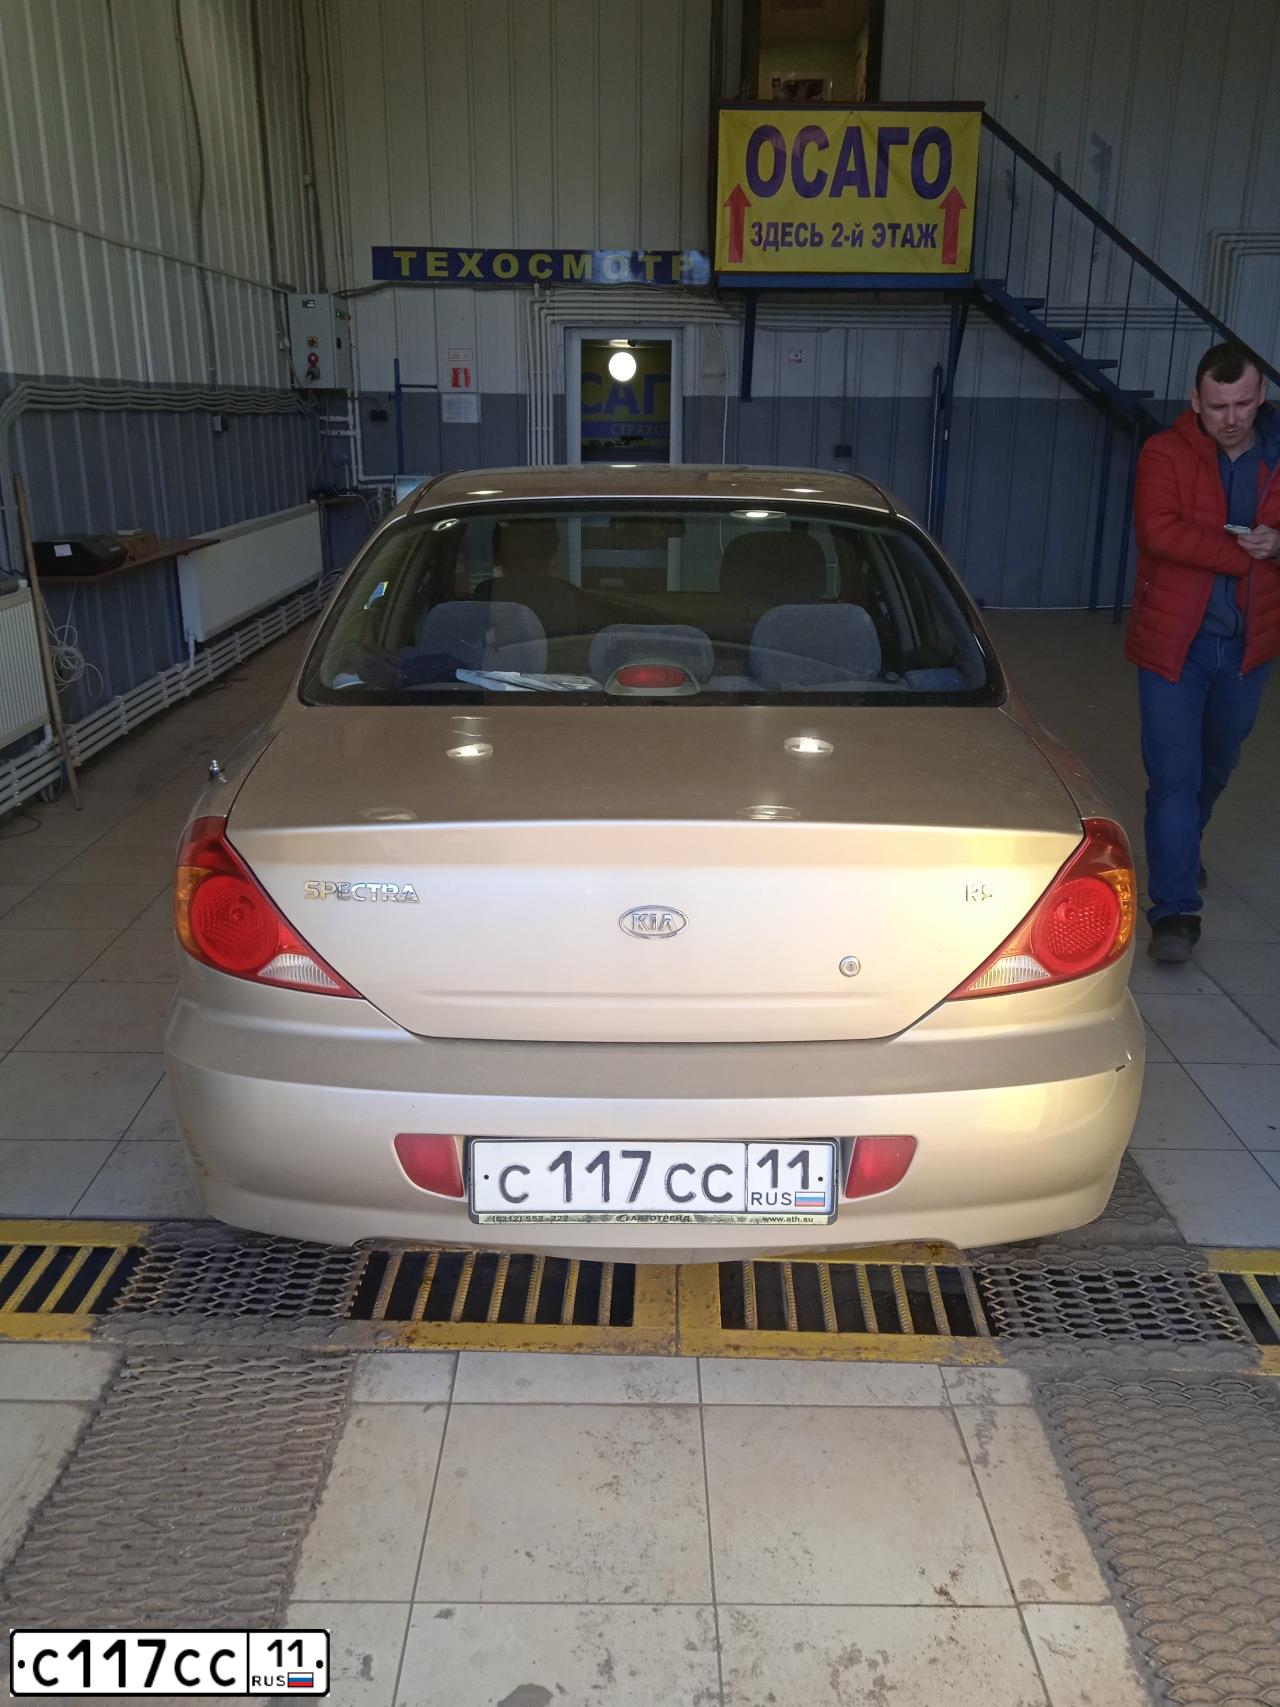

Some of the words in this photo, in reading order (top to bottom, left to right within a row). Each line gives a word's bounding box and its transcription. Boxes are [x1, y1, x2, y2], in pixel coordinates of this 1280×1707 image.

[745, 124, 953, 200] ОСАГО
[751, 221, 824, 252] ЗДЕСЬ
[871, 222, 938, 249] ЭТАЖ
[393, 251, 696, 282] ТЕХОСМОТР
[303, 880, 420, 903] SPECTRA
[965, 884, 993, 902] RS
[632, 913, 676, 931] KIA
[757, 1149, 810, 1190] 11
[751, 1192, 792, 1206] RUS
